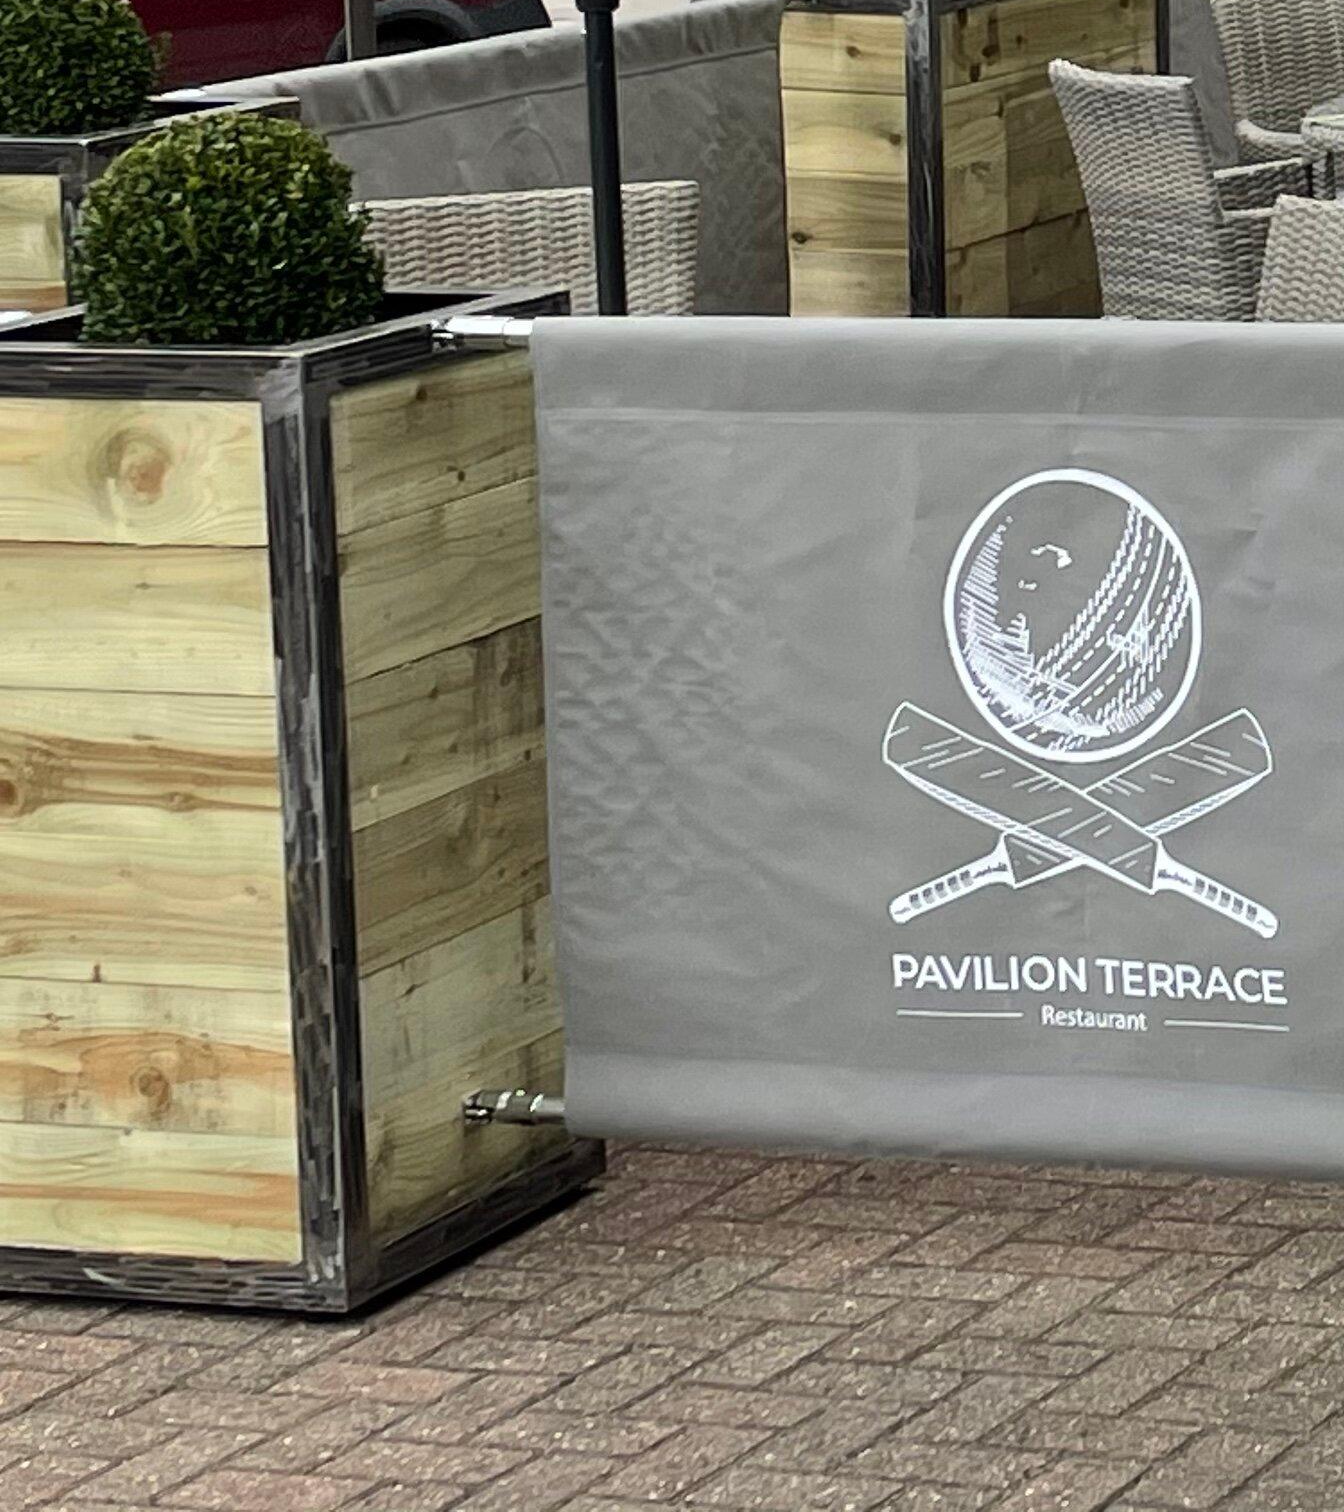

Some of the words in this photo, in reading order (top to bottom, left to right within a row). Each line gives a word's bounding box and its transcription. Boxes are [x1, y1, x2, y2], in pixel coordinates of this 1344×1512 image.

[892, 952, 1088, 992] PAVILION
[1094, 958, 1289, 1005] TERRACE
[1040, 1004, 1149, 1031] Restaurant
